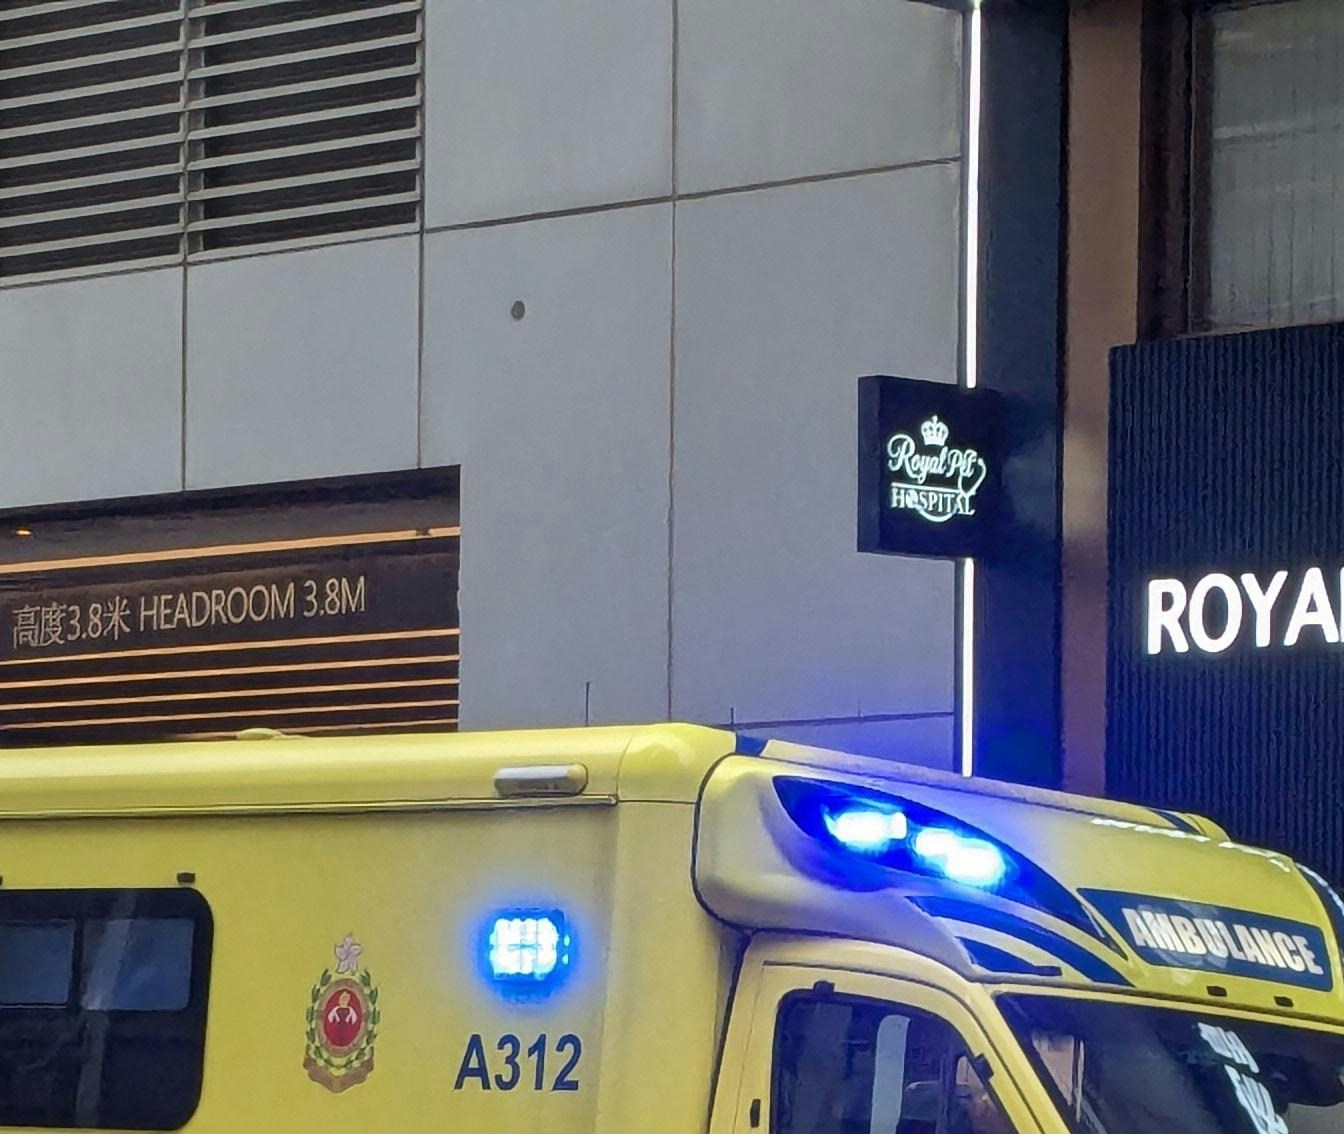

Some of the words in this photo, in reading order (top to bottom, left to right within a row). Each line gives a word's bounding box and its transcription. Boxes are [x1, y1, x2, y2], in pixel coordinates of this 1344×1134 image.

[887, 434, 947, 484] Royal
[891, 488, 976, 516] HOSPITAL
[12, 595, 131, 649] 高度3.8米
[139, 582, 296, 632] HEADROOM
[302, 576, 367, 618] 3.8M
[1121, 907, 1325, 976] AMBULANCE
[454, 1033, 582, 1092] A312
